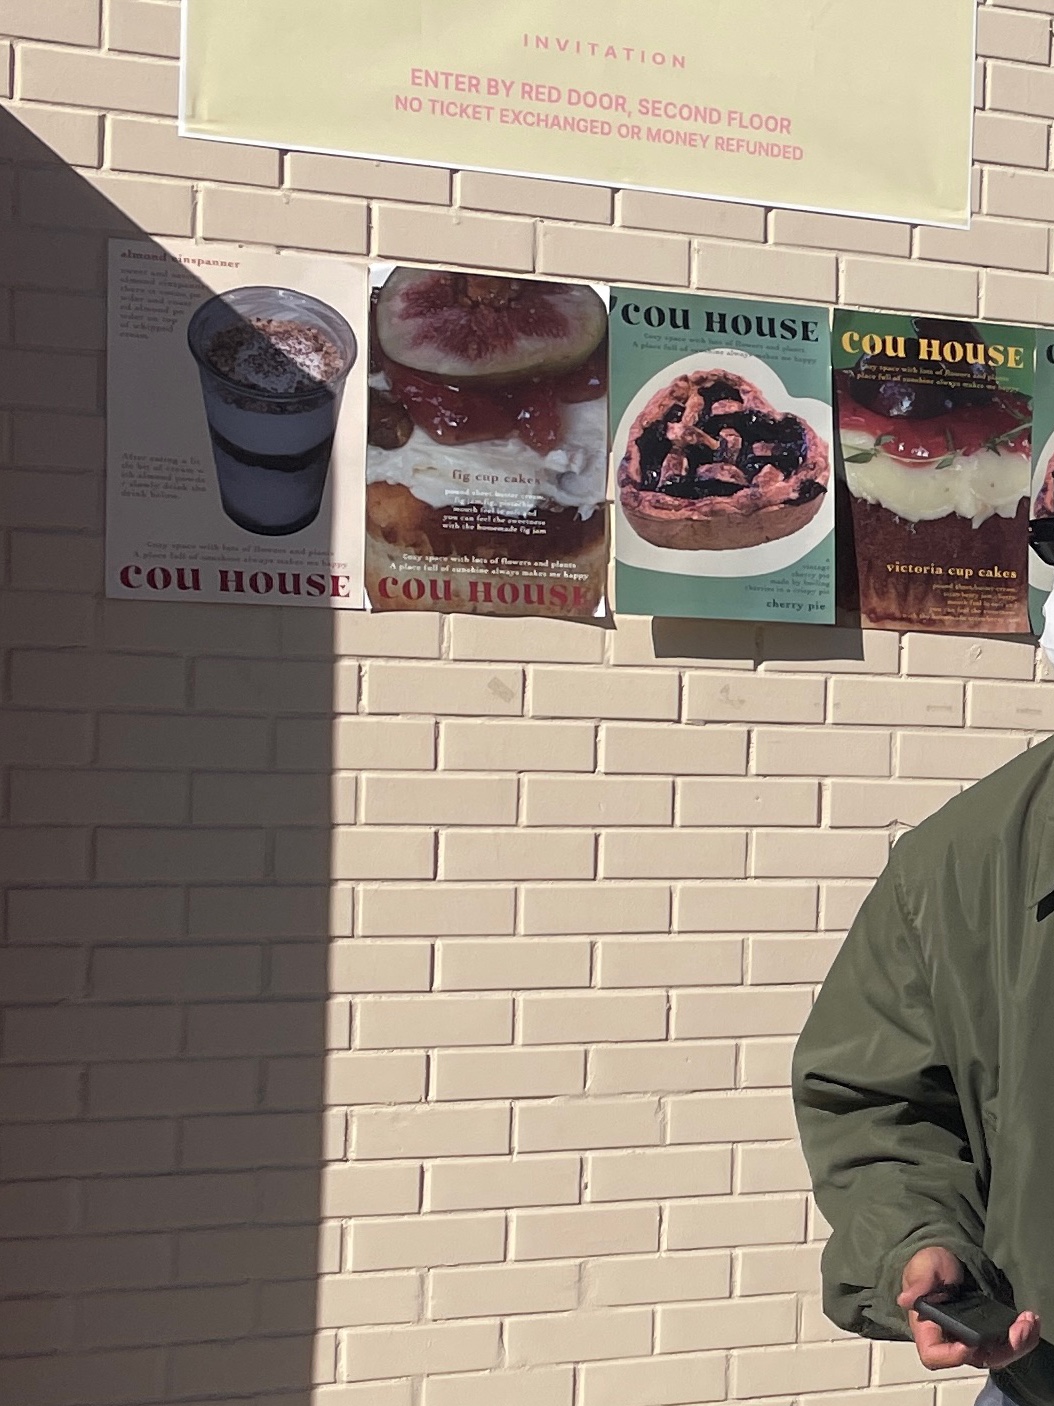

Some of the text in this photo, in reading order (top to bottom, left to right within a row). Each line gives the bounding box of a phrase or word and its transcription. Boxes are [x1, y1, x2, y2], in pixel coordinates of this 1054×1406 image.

[523, 33, 687, 68] INVITATION
[410, 67, 791, 135] ENTER BY RED DOOR, SECOND FLOOR
[394, 94, 804, 161] NO TICKET EXCHANGED OR MONEY REFUNDED
[121, 249, 241, 269] almond einspanner
[621, 303, 820, 343] COU HOUSE
[841, 331, 1025, 369] COU HOUSE
[452, 469, 541, 485] fig cup cakes
[119, 564, 350, 598] COU HOUSE
[886, 561, 1018, 579] victoria cup cakes
[378, 576, 590, 608] COU HOUSE
[766, 598, 826, 612] cherry pie
